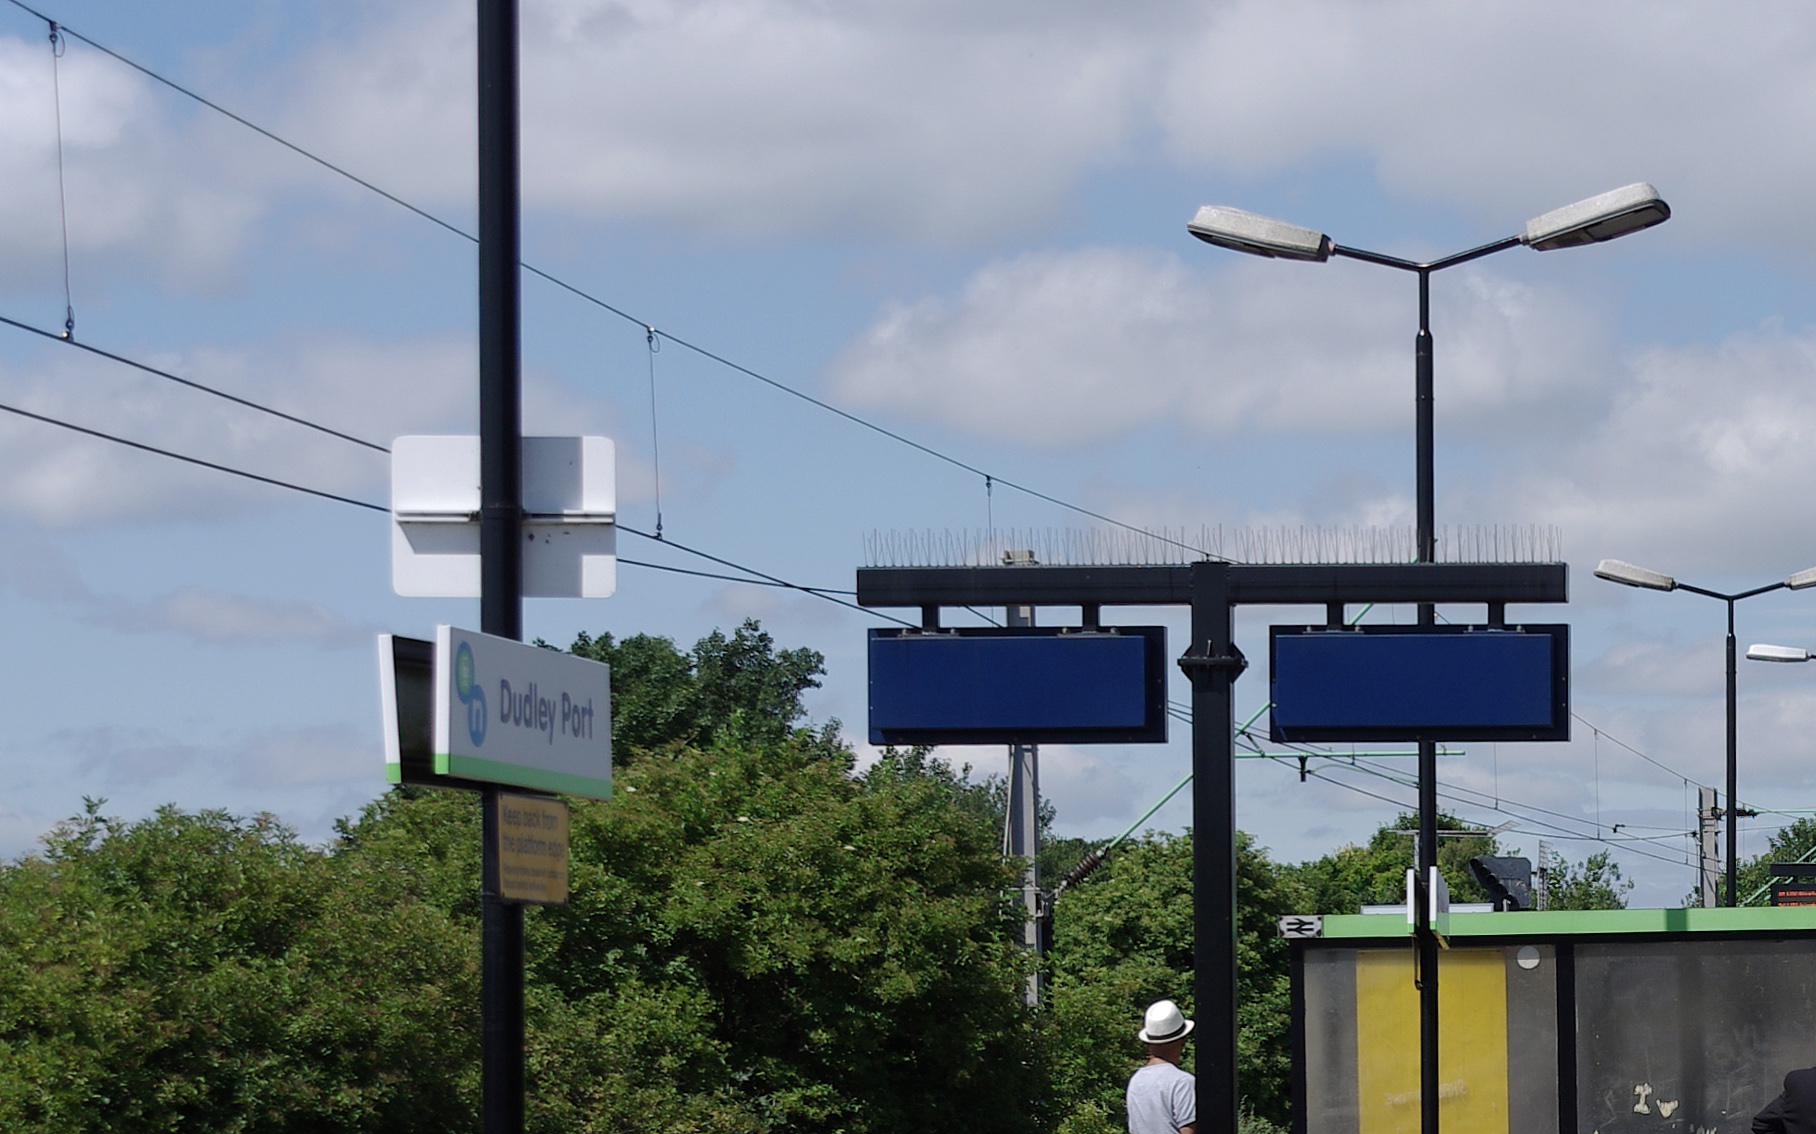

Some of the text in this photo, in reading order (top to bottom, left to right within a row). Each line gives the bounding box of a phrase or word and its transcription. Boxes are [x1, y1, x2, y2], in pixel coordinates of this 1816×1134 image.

[500, 678, 595, 746] Dudley Port
[503, 805, 522, 829] Keep
[523, 806, 541, 829] back
